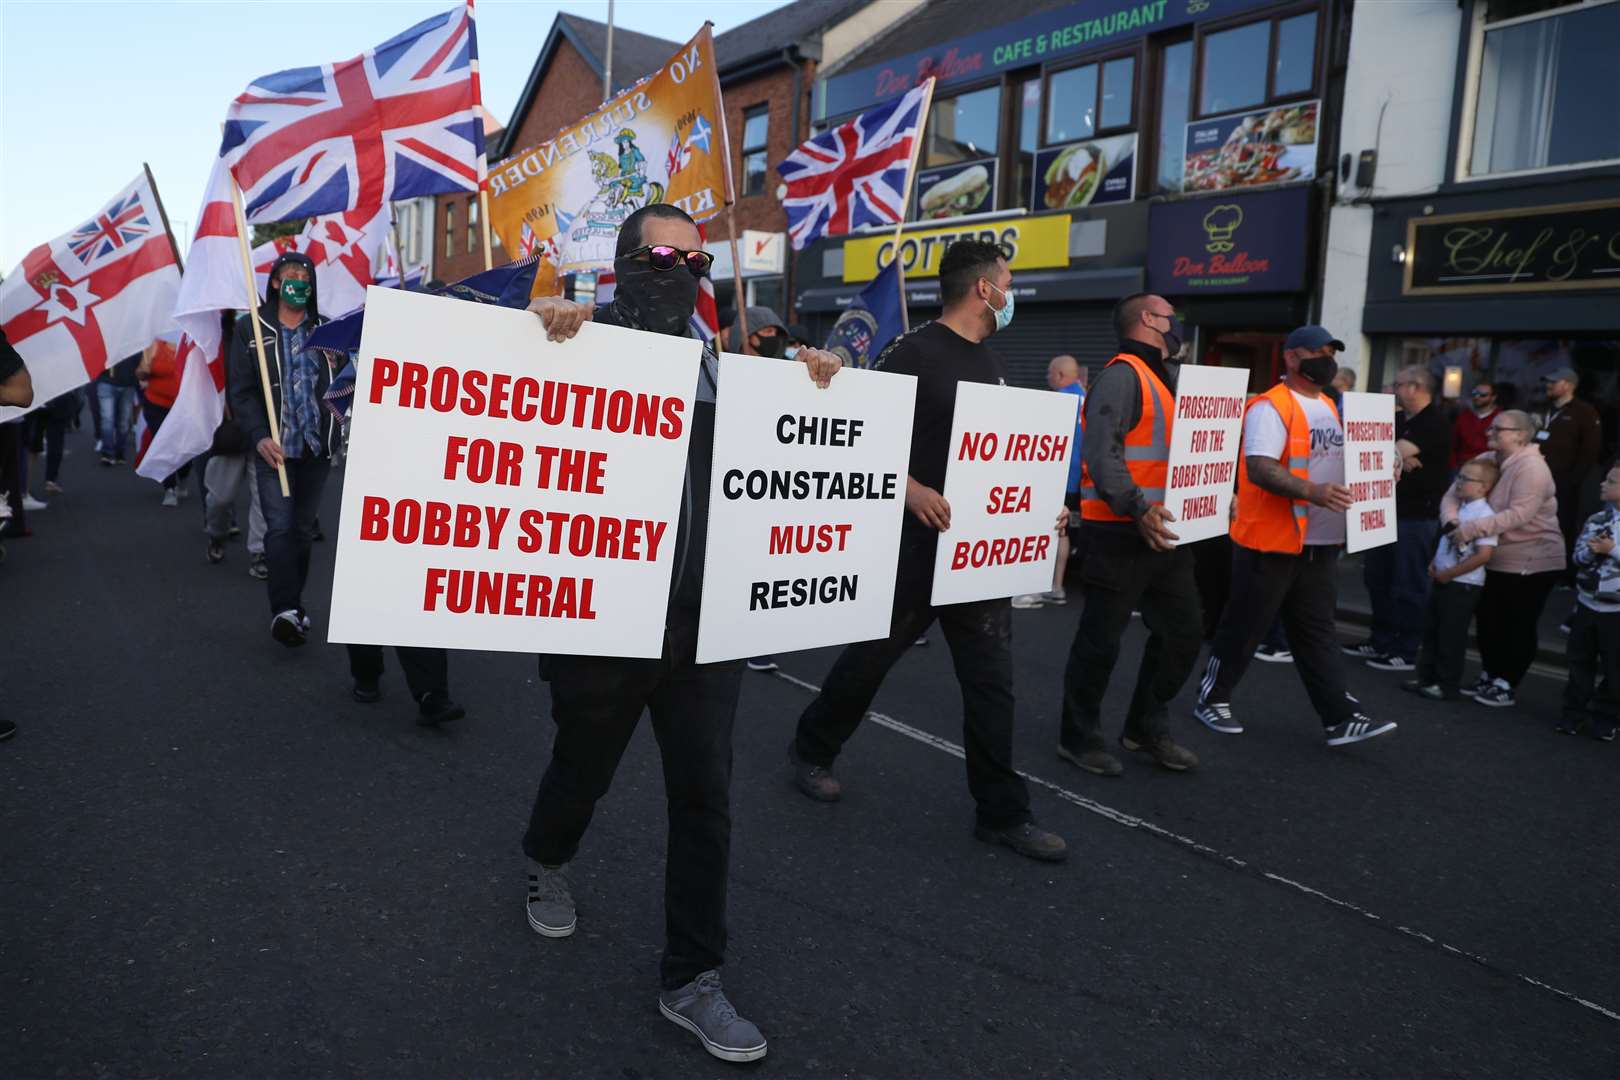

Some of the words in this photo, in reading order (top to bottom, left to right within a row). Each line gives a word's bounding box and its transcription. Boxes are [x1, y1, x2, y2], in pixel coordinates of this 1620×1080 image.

[992, 38, 1032, 65] CAFE
[1035, 34, 1048, 53] &
[1051, 0, 1168, 49] RESTAURANT
[1173, 256, 1204, 277] Don
[1208, 252, 1270, 274] Balloon
[1443, 227, 1553, 284] Chef
[1545, 227, 1599, 282] &
[369, 358, 685, 440] PROSECUTIONS
[1178, 395, 1244, 420] PROSECUTIONS
[776, 414, 864, 447] CHIEF
[1190, 430, 1208, 453] FOR
[1210, 430, 1225, 452] THE
[1347, 421, 1393, 443] PROSECUTIONS
[958, 432, 998, 462] NO
[1004, 434, 1069, 462] IRISH
[1359, 451, 1372, 472] FOR
[1372, 451, 1384, 471] THE
[444, 436, 524, 486] FOR
[535, 445, 608, 494] THE
[1171, 465, 1203, 489] BOBBY
[1203, 461, 1235, 486] STOREY
[722, 469, 898, 500] CONSTABLE
[1349, 480, 1371, 503] BOBBY
[1371, 479, 1393, 500] STOREY
[986, 486, 1032, 515] SEA
[1182, 495, 1218, 521] FUNERAL
[360, 495, 510, 550] BOBBY
[517, 509, 668, 562] STOREY
[1360, 509, 1386, 532] FUNERAL
[769, 524, 852, 555] MUST
[951, 535, 1050, 571] BORDER
[423, 568, 596, 619] FUNERAL
[749, 574, 859, 611] RESIGN
